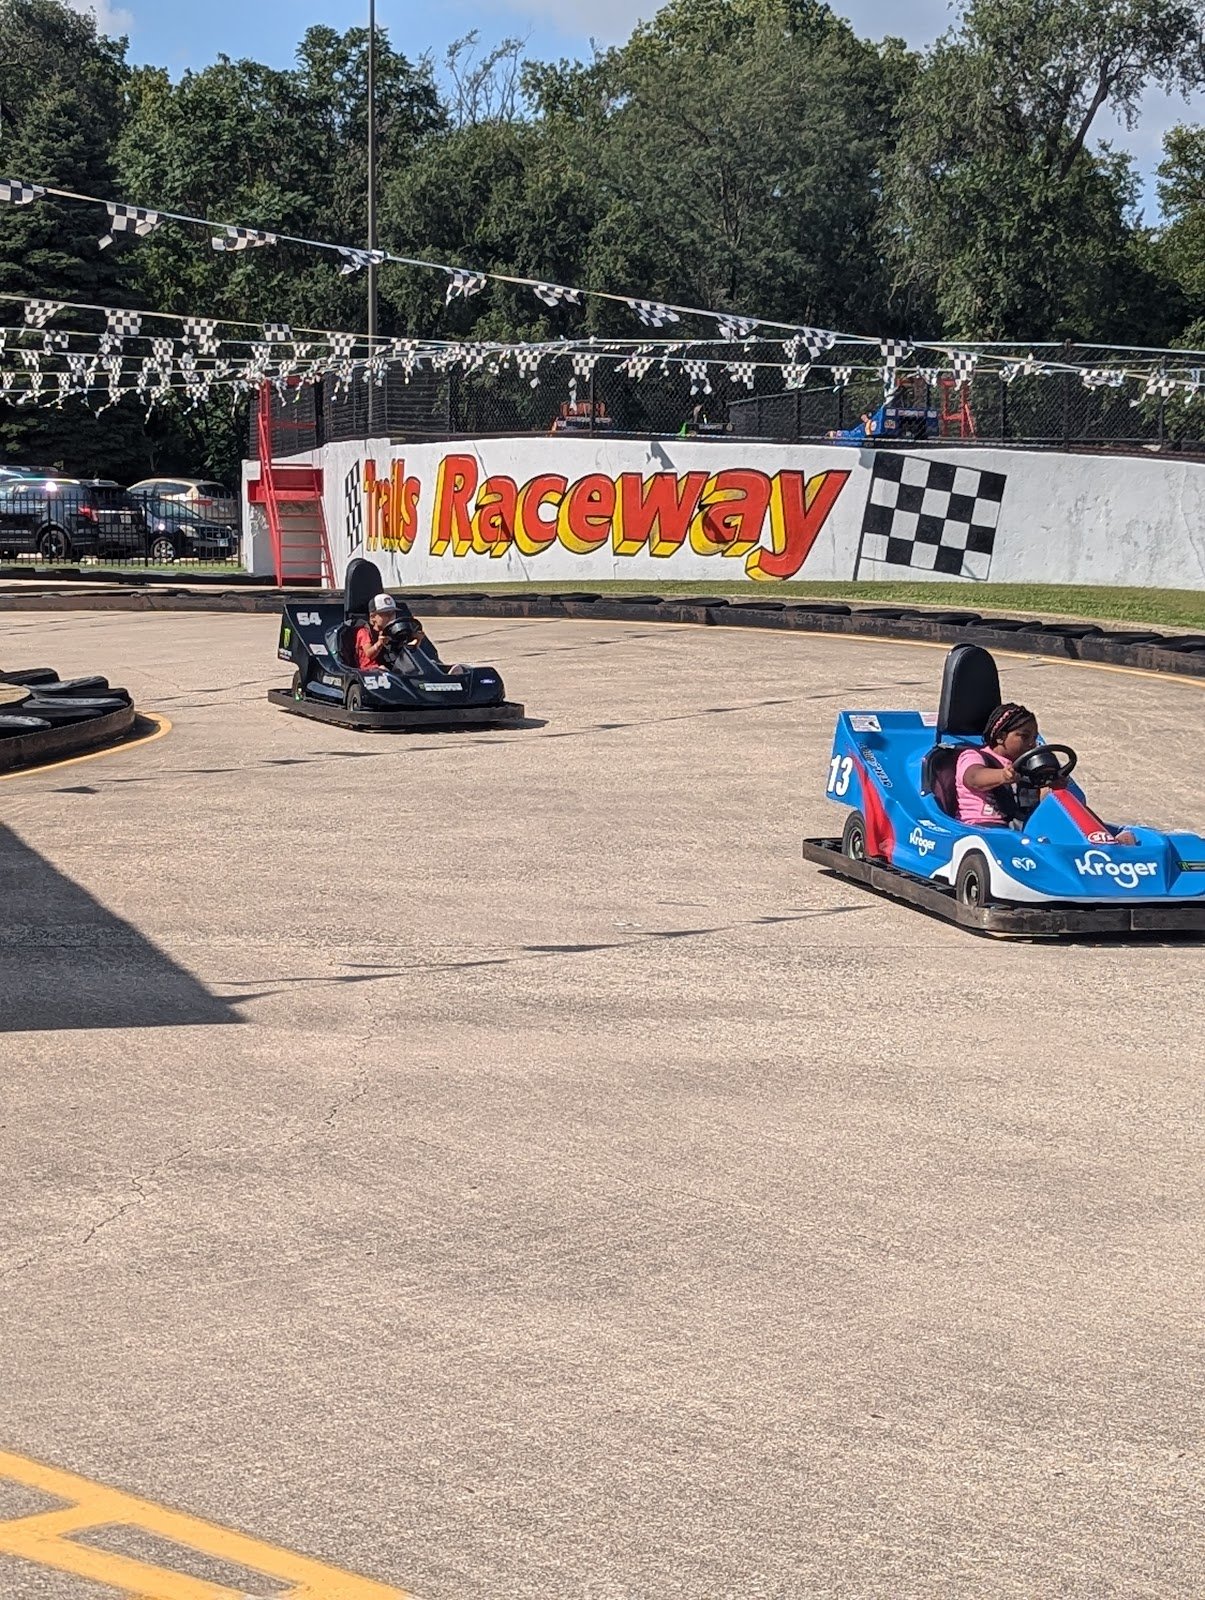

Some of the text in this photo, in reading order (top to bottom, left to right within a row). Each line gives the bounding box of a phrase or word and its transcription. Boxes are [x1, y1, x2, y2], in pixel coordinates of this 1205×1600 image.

[363, 453, 852, 582] Trails Raceway
[296, 611, 323, 626] 54
[363, 674, 391, 691] 54
[827, 754, 853, 796] 13
[909, 827, 936, 856] Kroger
[1074, 849, 1158, 889] Kroger
